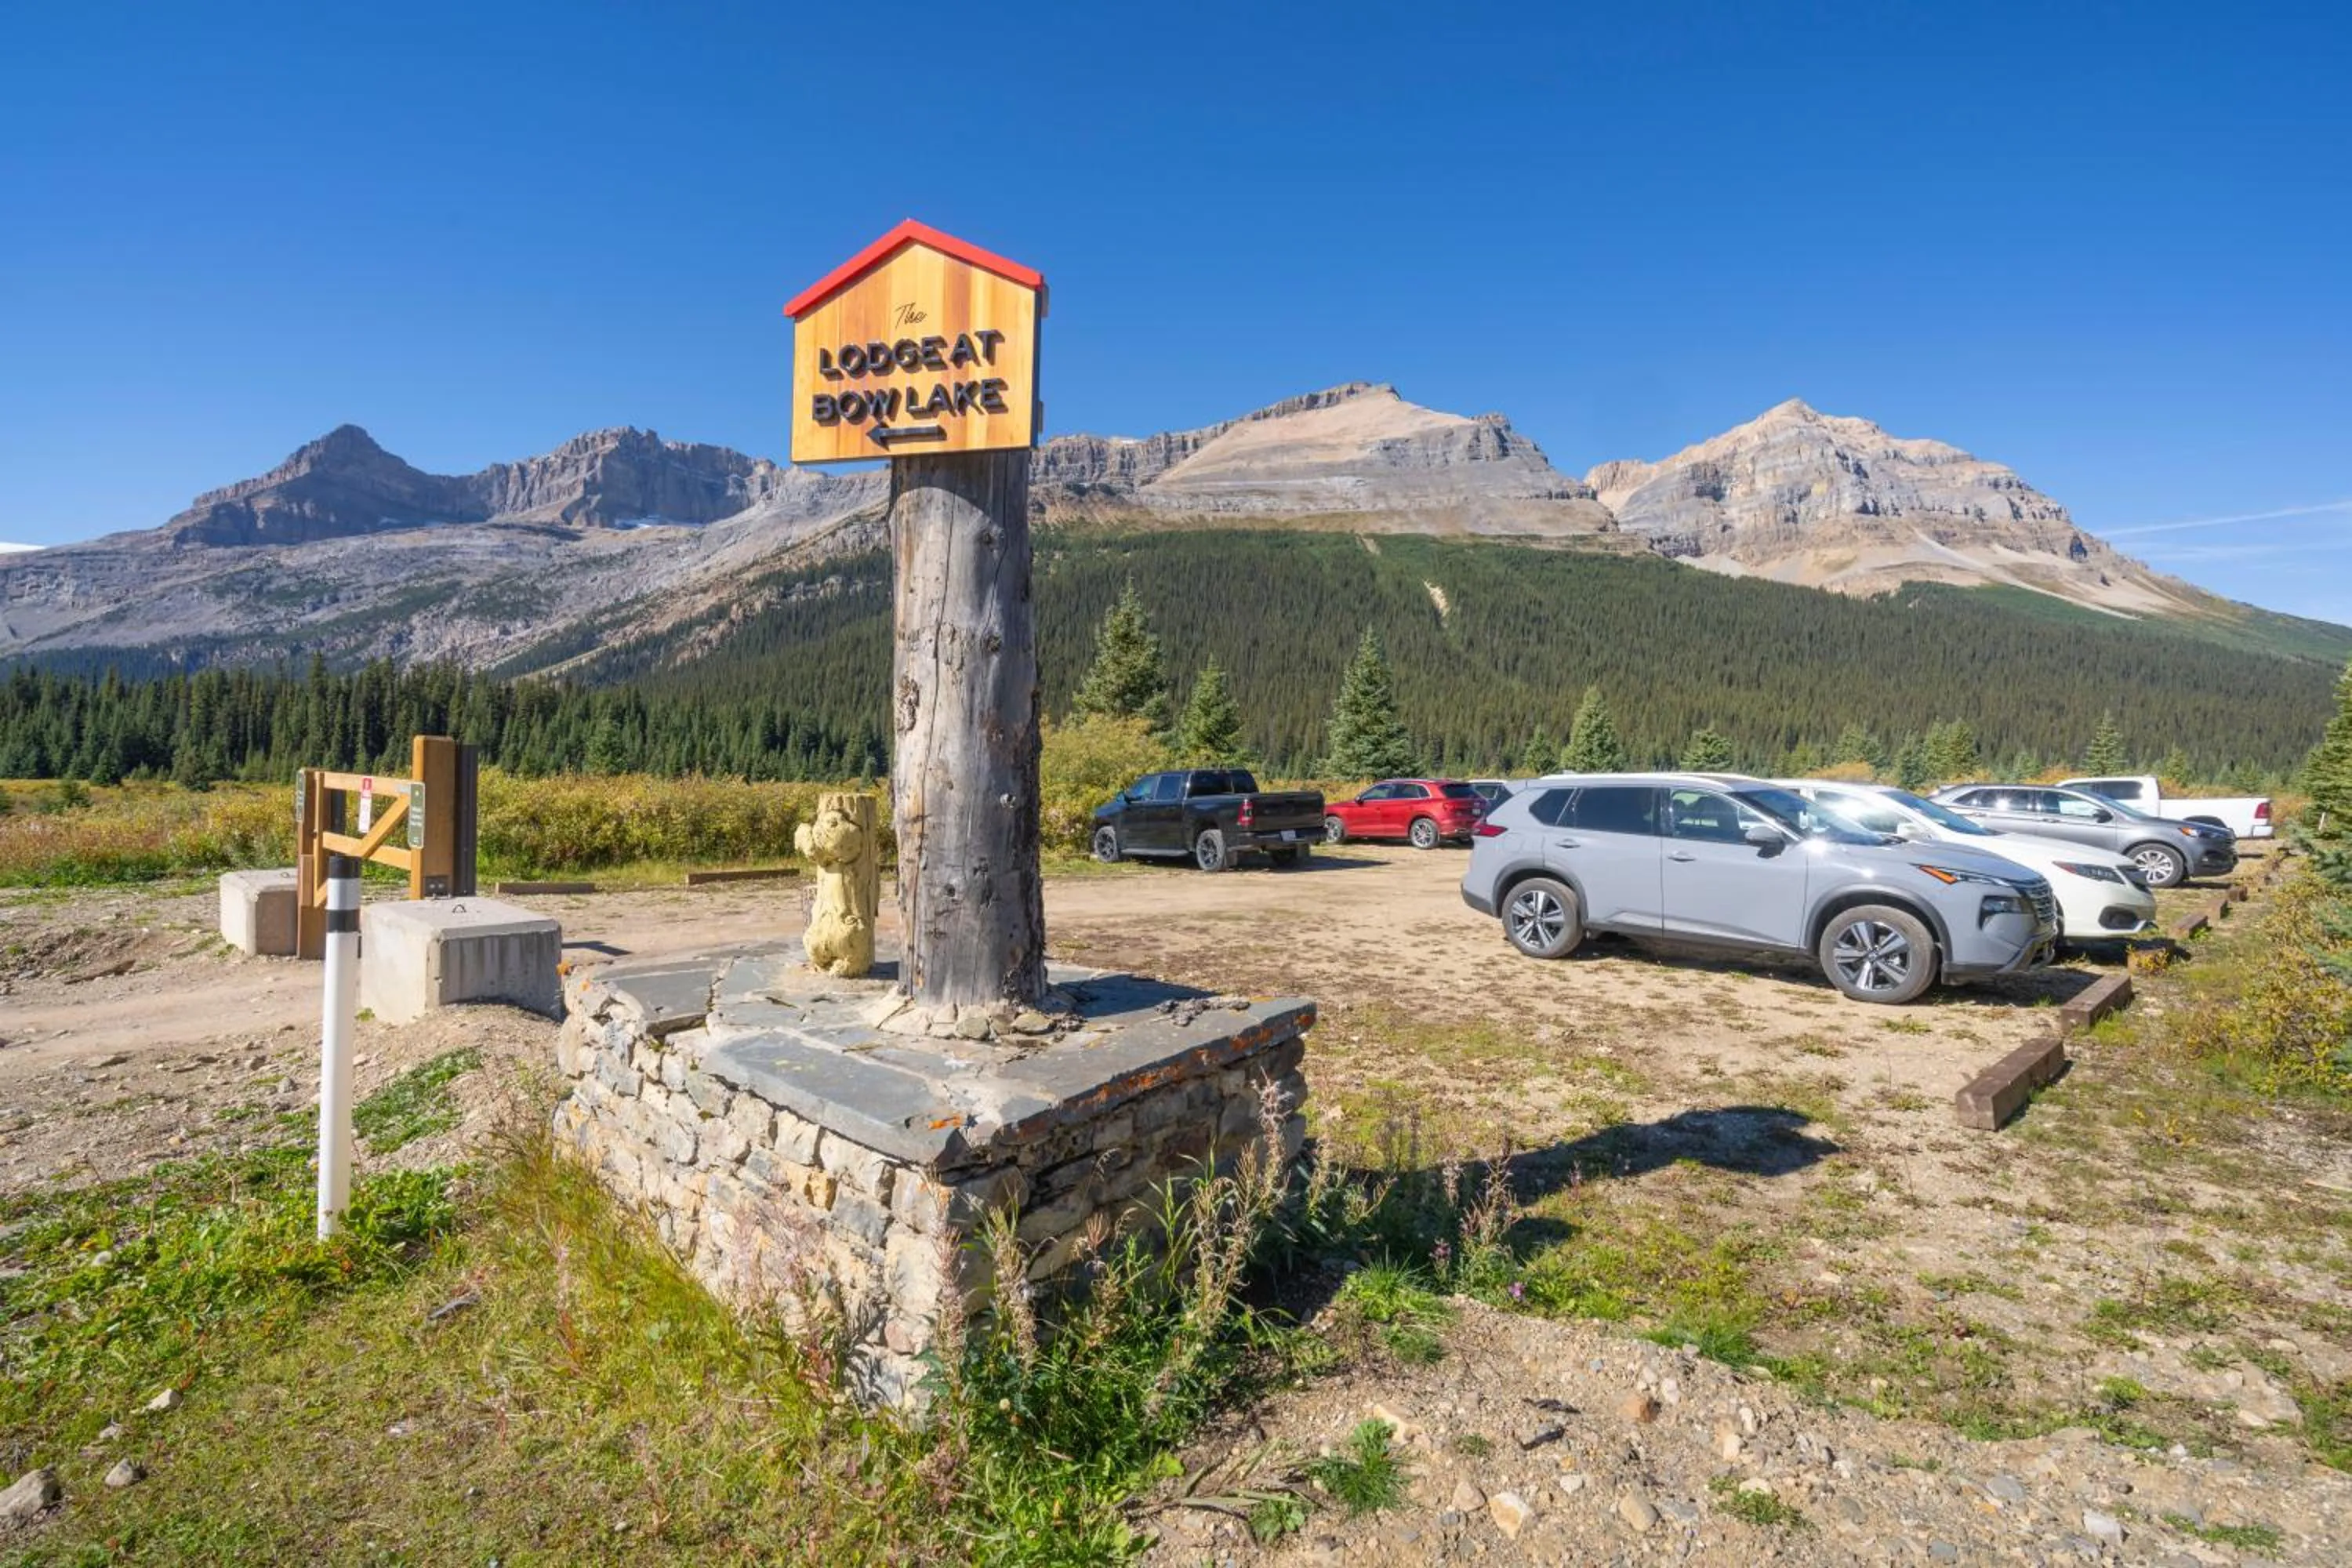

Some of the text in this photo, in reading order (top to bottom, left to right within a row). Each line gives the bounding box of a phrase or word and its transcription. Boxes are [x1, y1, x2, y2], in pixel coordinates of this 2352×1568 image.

[894, 302, 927, 329] The
[819, 329, 1005, 380] LODGE AT
[812, 378, 1008, 426] BOW LAKE
